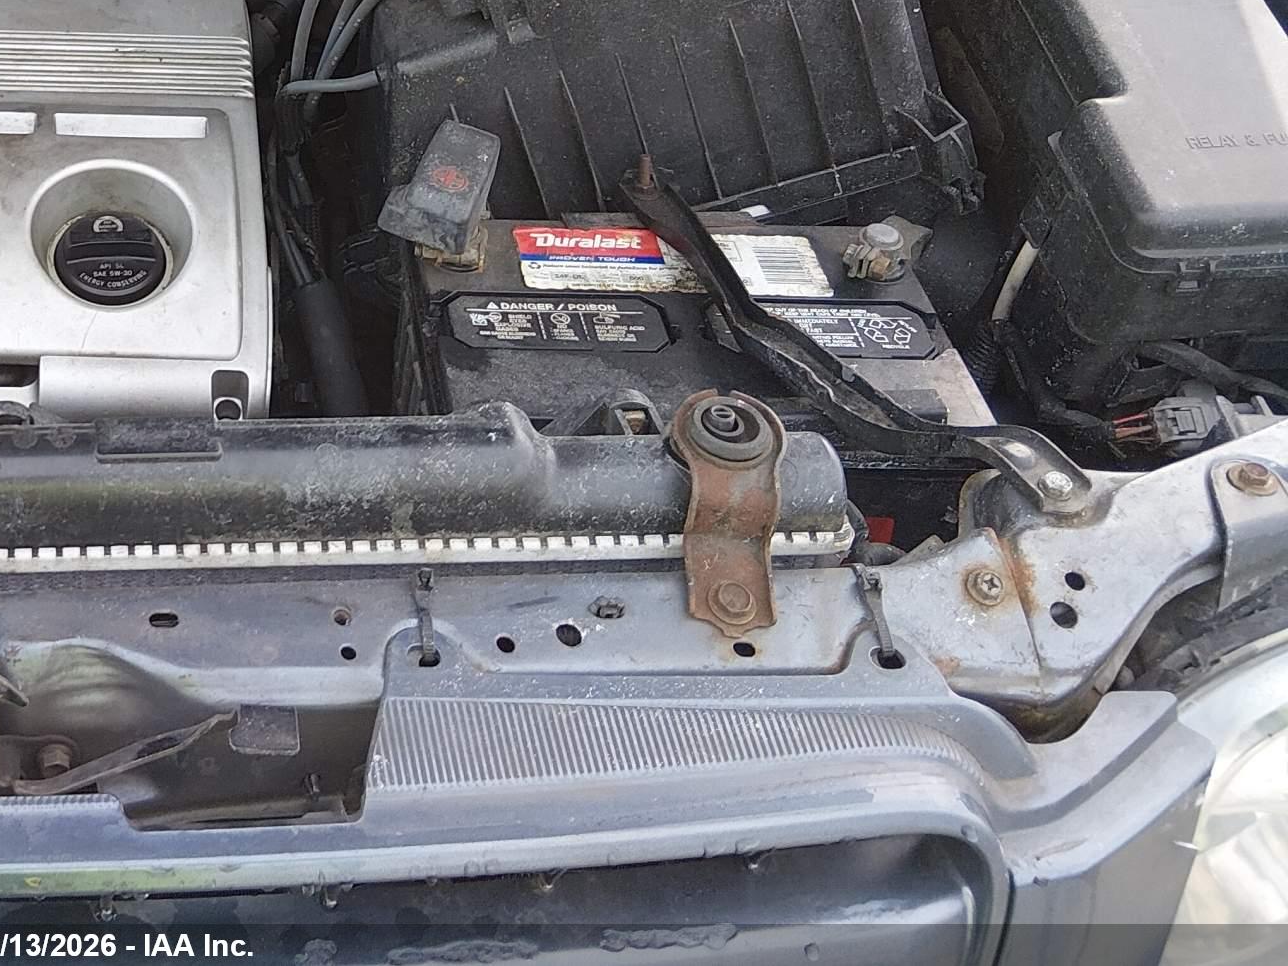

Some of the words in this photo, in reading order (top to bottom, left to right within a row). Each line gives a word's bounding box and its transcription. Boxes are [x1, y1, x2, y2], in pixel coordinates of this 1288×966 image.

[1185, 134, 1240, 149] RELAY
[1244, 132, 1261, 147] &
[529, 233, 642, 250] Duralast
[79, 272, 105, 287] ENERGY
[106, 270, 148, 288] CONSERVING
[501, 302, 555, 311] DANGER
[568, 303, 618, 312] POISON
